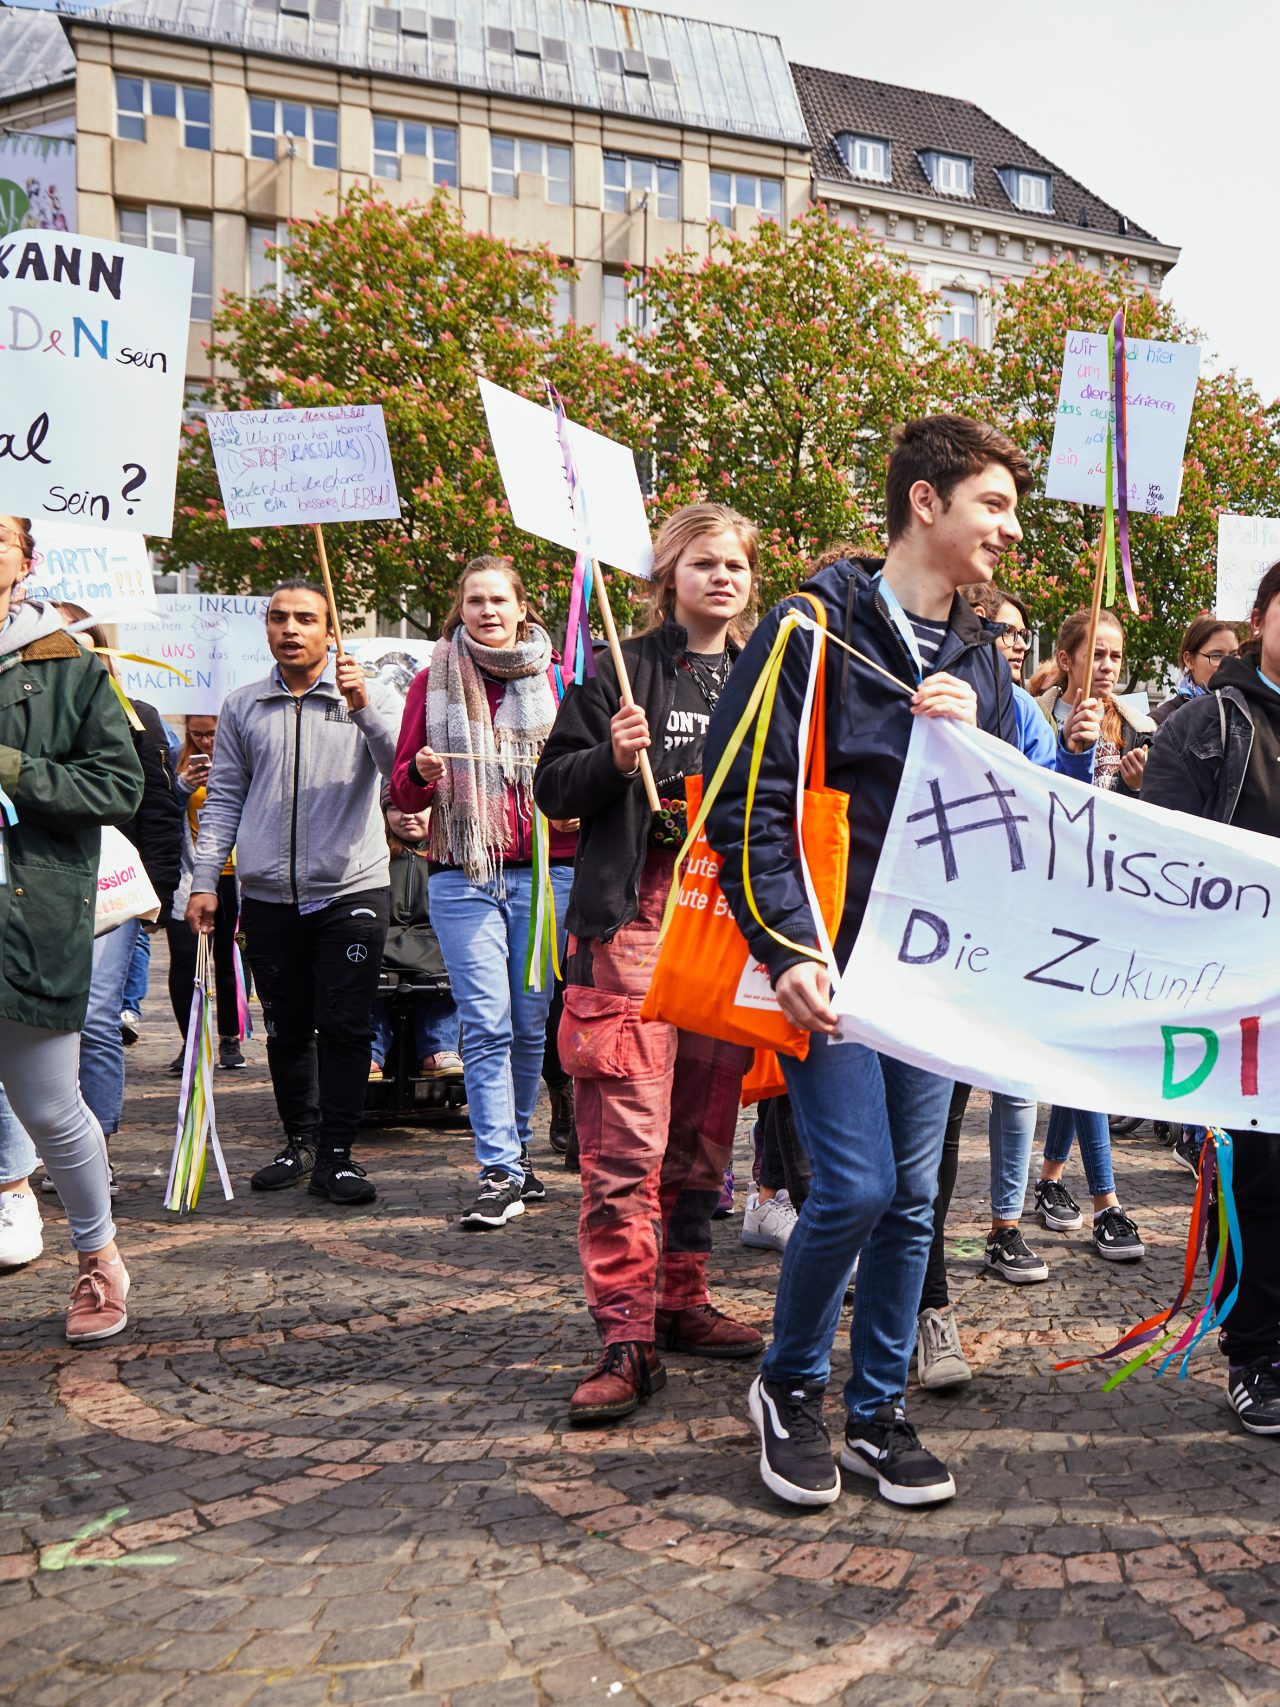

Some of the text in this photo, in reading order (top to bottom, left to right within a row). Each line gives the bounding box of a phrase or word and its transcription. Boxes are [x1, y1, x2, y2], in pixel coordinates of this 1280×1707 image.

[116, 346, 167, 373] sein
[1068, 335, 1098, 356] Wir
[1146, 346, 1176, 364] hier
[208, 412, 234, 428] Wir
[240, 444, 286, 473] STOP
[161, 642, 196, 659] UNS
[127, 669, 213, 690] MACHEN
[906, 771, 1271, 918] #Mission
[898, 908, 990, 973] Die
[1023, 926, 1226, 1008] Zukunft
